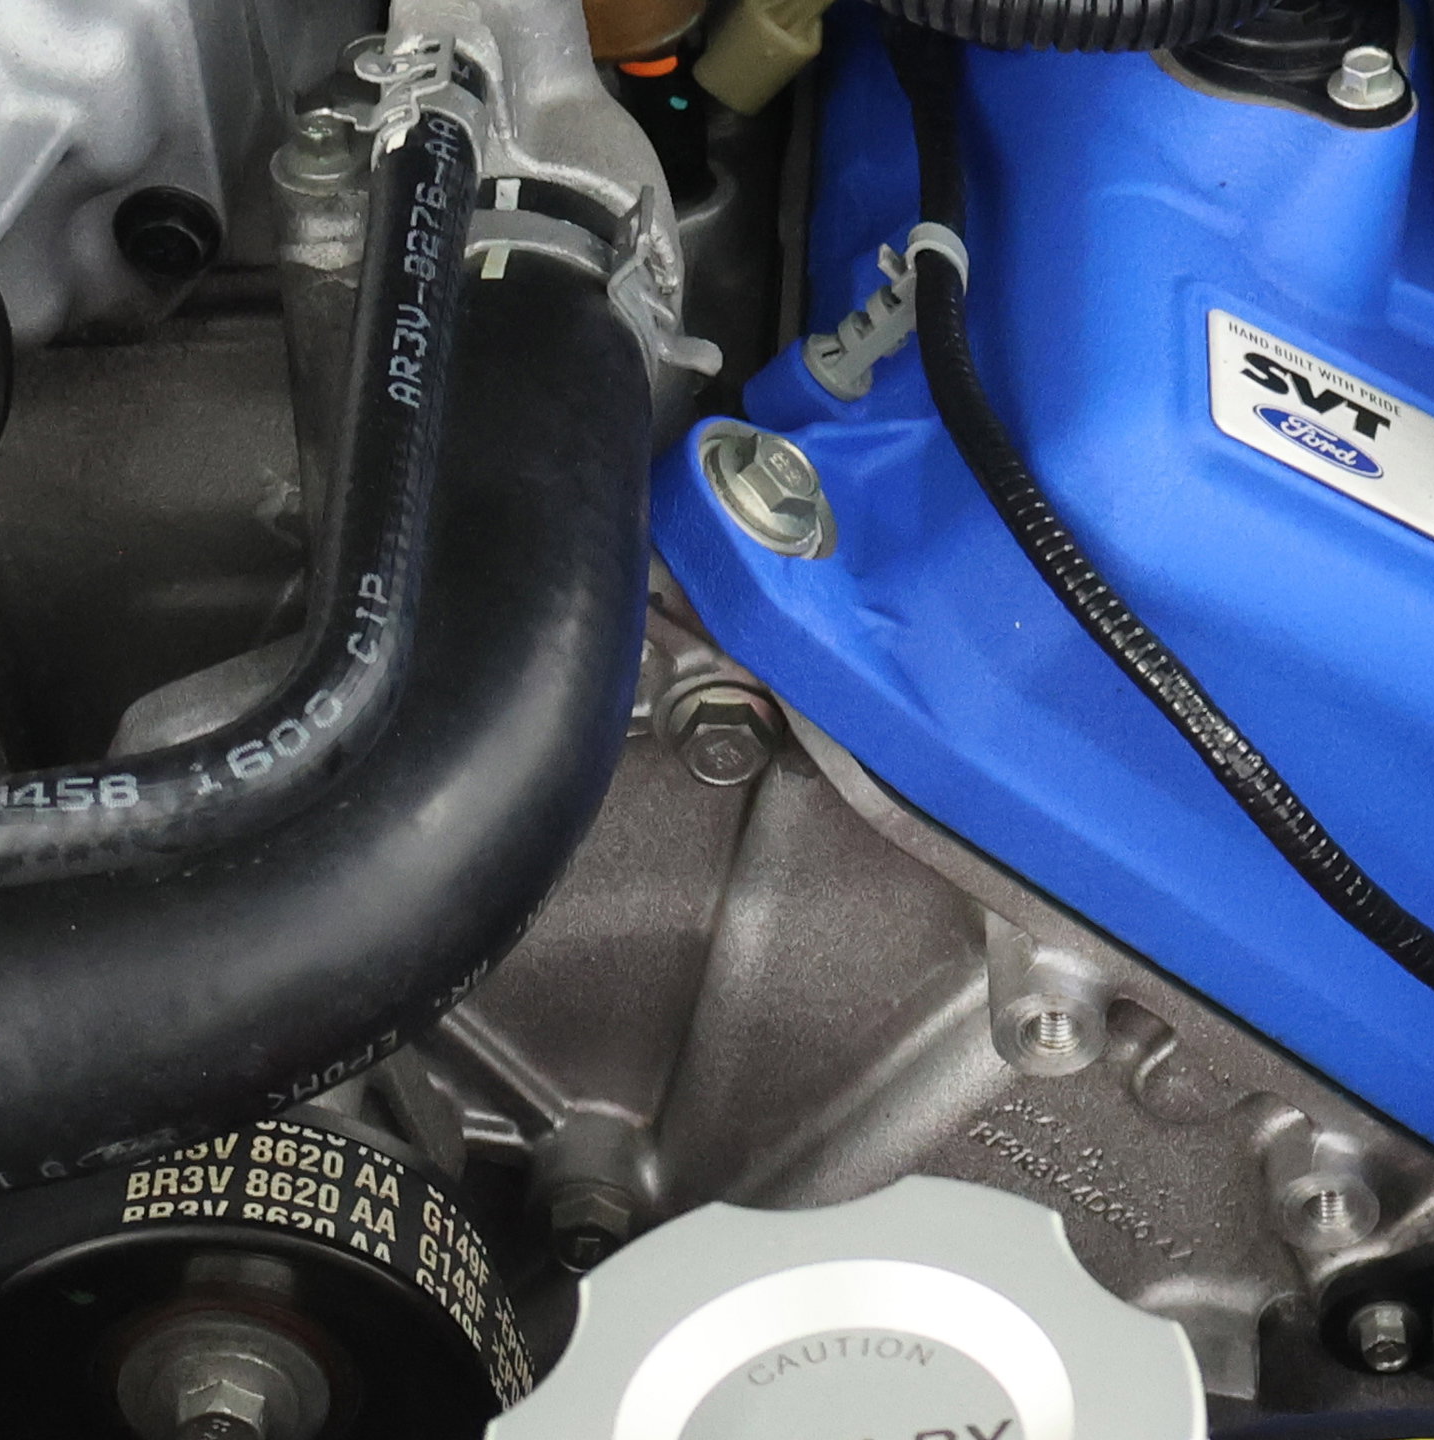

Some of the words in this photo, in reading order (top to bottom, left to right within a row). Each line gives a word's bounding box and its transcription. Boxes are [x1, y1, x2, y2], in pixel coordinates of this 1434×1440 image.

[1240, 351, 1392, 442] SVT
[1317, 367, 1356, 395] WITH
[1359, 386, 1403, 418] PRIDE
[1279, 415, 1358, 466] Ford
[347, 572, 390, 665] CIP
[126, 1165, 234, 1202] BR3V
[244, 1169, 340, 1215] 8620
[349, 1196, 397, 1242] AA
[417, 1234, 486, 1322] G149F
[250, 1135, 345, 1180] 8620
[353, 1164, 401, 1208] AA
[422, 1201, 490, 1288] G149F
[747, 1335, 936, 1387] CAUTION
